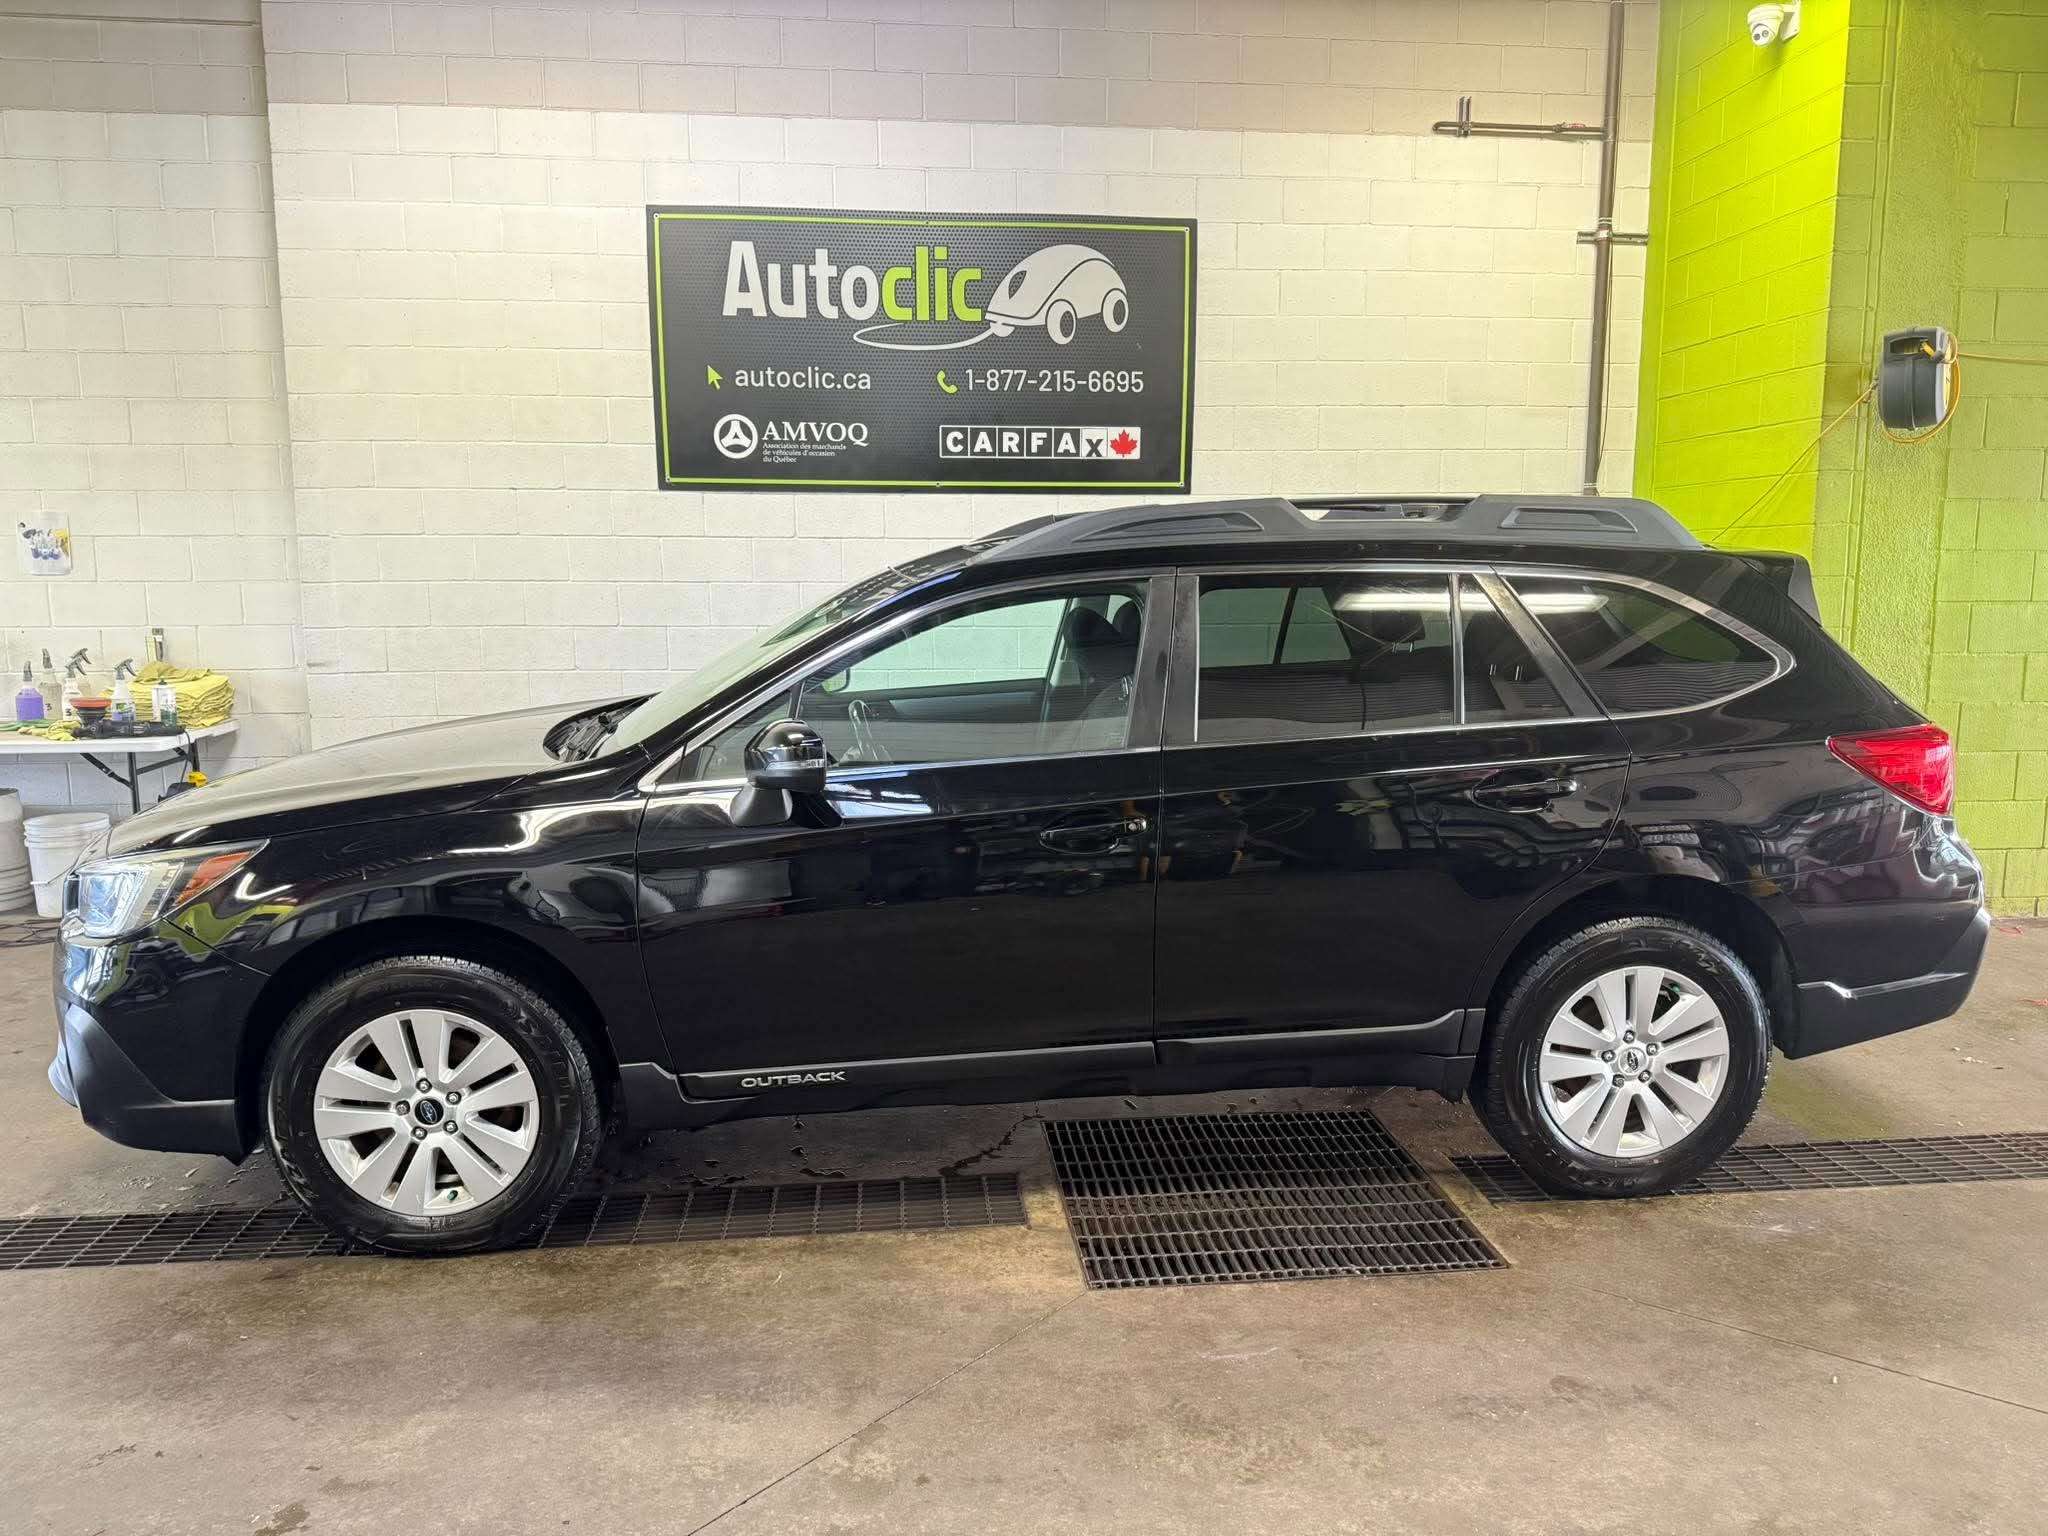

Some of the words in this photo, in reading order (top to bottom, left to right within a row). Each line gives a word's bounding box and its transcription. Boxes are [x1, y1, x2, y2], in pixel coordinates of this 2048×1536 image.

[722, 240, 983, 322] Autoclic
[735, 366, 871, 390] autoclic.ca
[965, 368, 1144, 393] 1-877-215-6695
[762, 421, 870, 447] AMVOQ
[945, 430, 1104, 458] CARFAX
[763, 442, 799, 450] Association
[812, 443, 847, 451] marchands
[773, 456, 797, 464] Québec
[740, 1071, 846, 1088] OUTBACK
